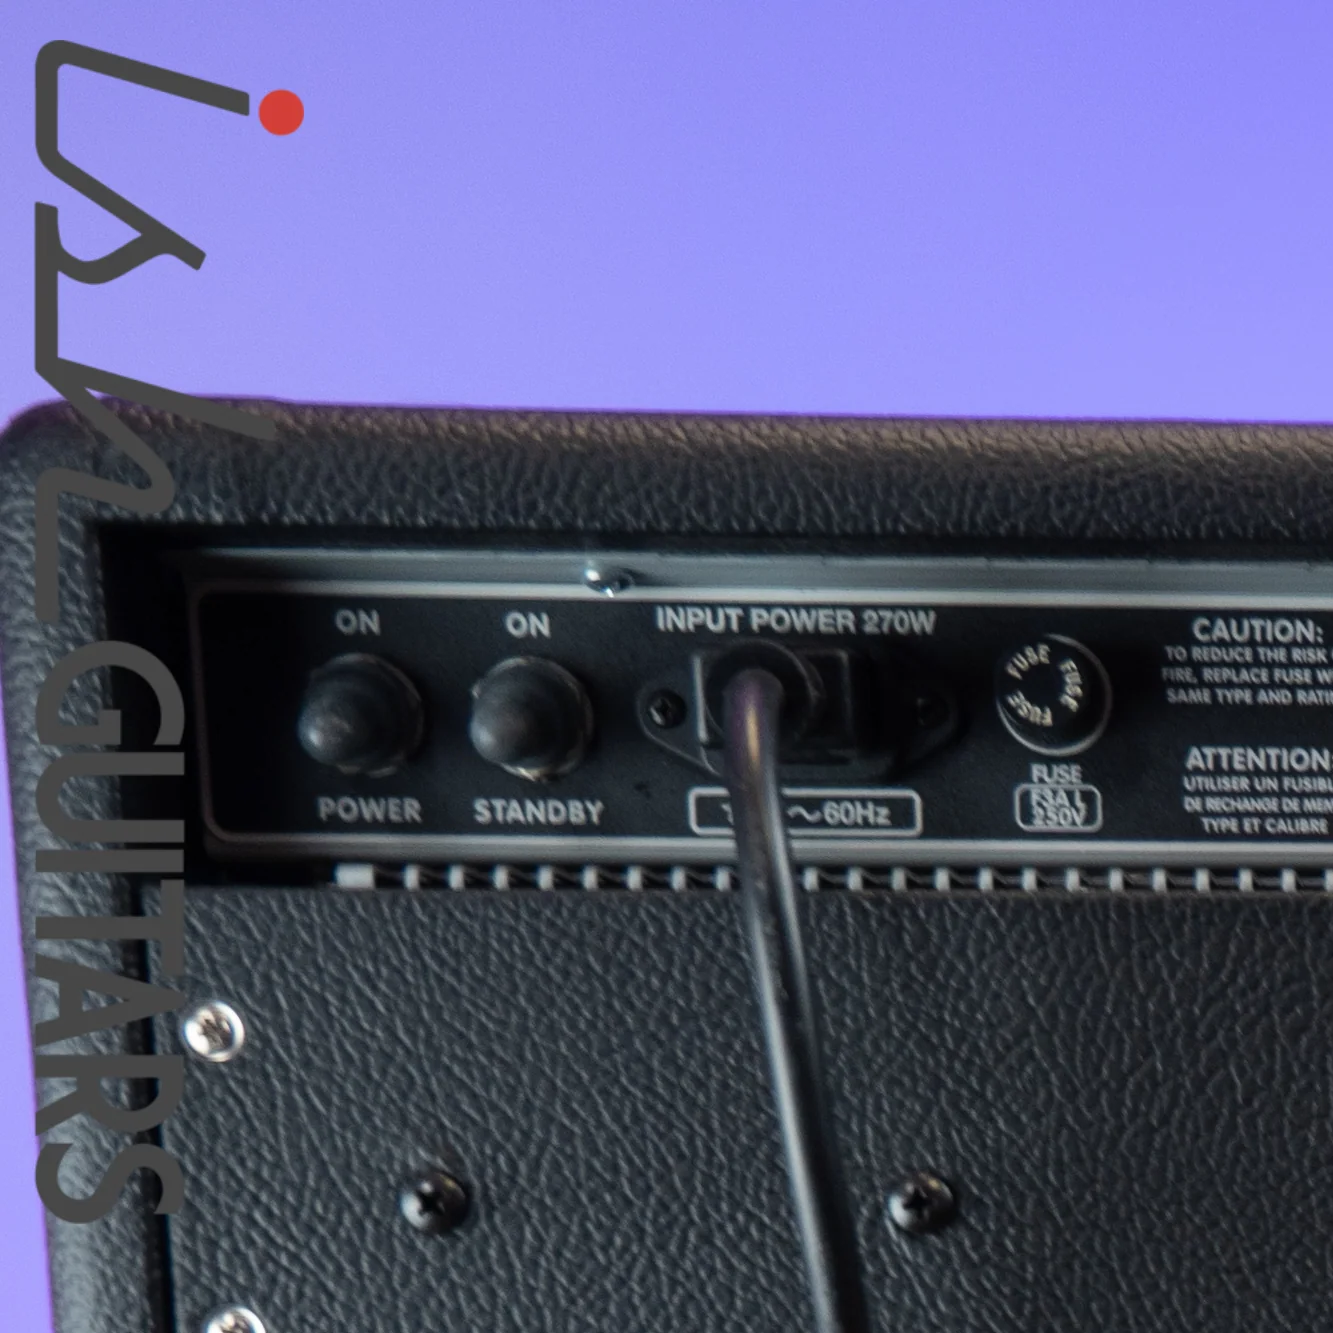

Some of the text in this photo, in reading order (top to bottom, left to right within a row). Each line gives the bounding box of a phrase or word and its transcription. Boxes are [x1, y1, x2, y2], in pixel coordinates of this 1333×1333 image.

[335, 609, 380, 635] ON
[507, 611, 551, 639] ON
[654, 606, 937, 636] INPUT POWER 270W
[1191, 617, 1324, 644] CAUTION:
[1005, 642, 1051, 680] FUSE
[1164, 645, 1188, 662] TO
[1190, 646, 1254, 663] REDUCE
[1257, 646, 1289, 663] THE
[1290, 647, 1328, 664] RISK
[1161, 666, 1199, 684] FIRE,
[1201, 667, 1270, 685] REPLACE
[1273, 667, 1314, 685] FUSE
[1166, 687, 1212, 705] SAME
[1214, 688, 1254, 706] TYPE
[1256, 688, 1293, 706] AND
[1030, 762, 1084, 785] FUSE
[1183, 775, 1252, 792] UTILISER
[1253, 776, 1280, 793] UN
[317, 796, 423, 823] POWER
[474, 798, 604, 825] STANDBY
[1201, 816, 1330, 835] TYPE ET CALIBRE
